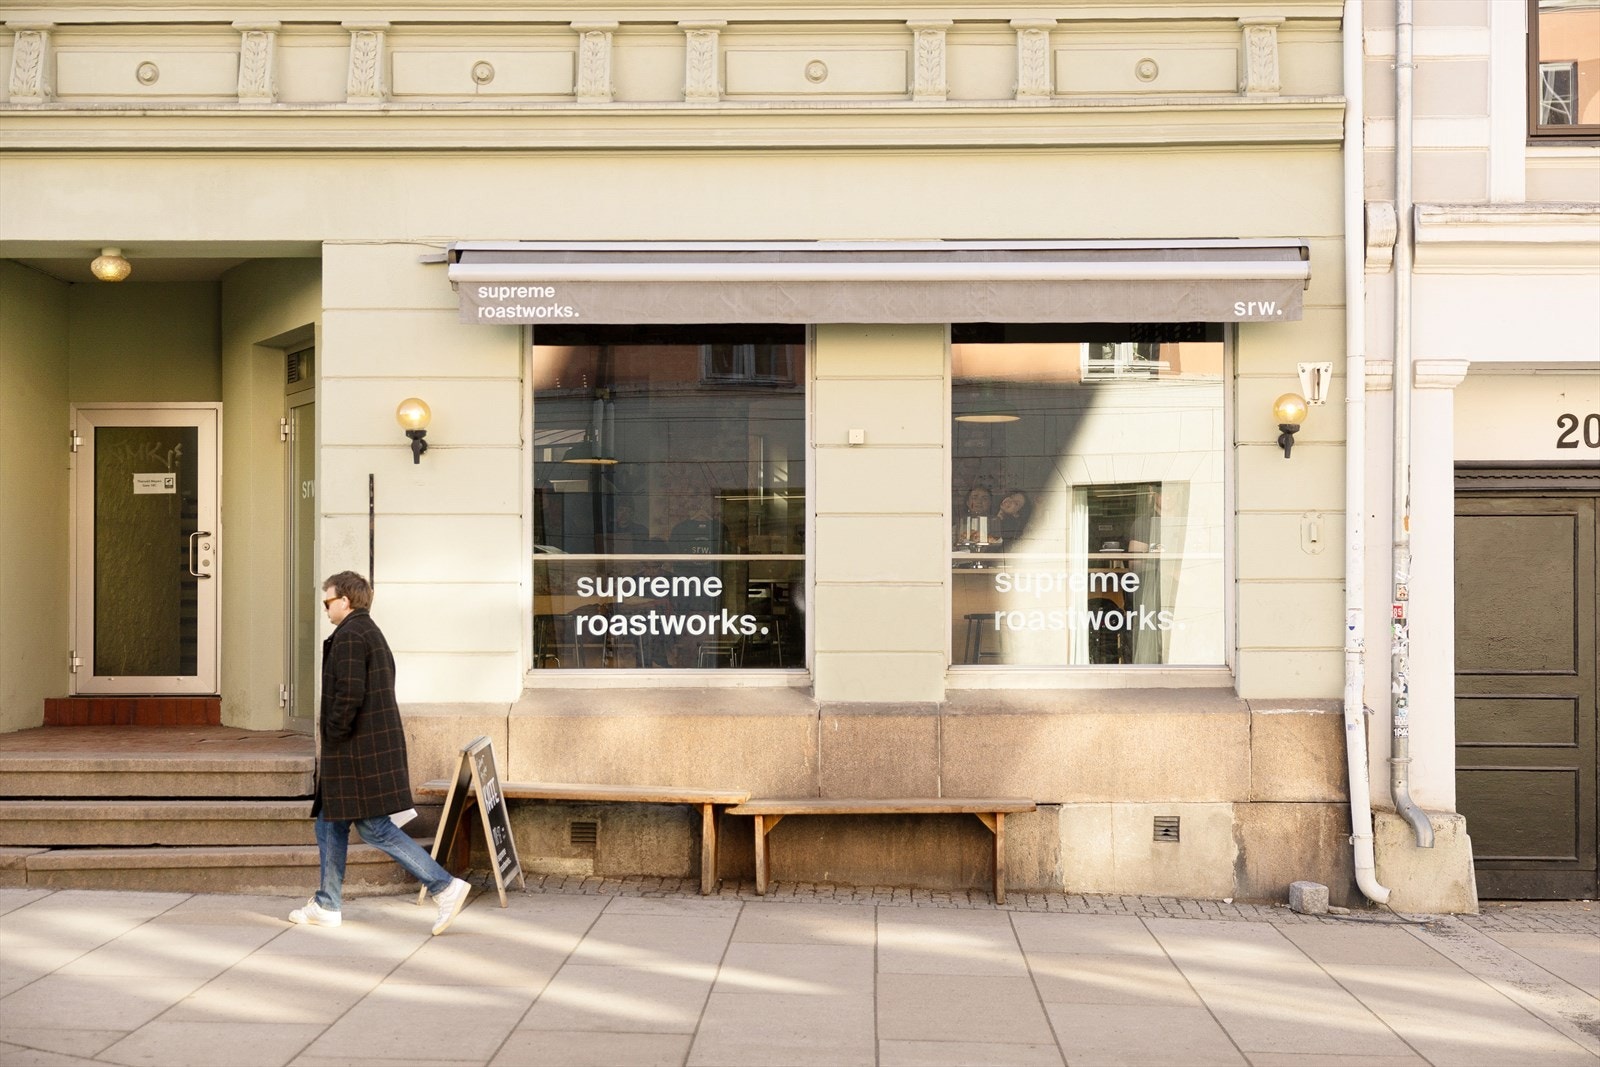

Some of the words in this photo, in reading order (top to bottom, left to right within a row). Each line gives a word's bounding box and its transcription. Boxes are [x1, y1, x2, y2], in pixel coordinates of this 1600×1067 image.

[478, 286, 555, 301] supreme
[478, 303, 580, 318] roastworks.
[1233, 301, 1283, 316] srw.
[1556, 413, 1600, 449] 20
[577, 575, 723, 603] supreme
[995, 571, 1140, 600] supreme
[576, 608, 769, 636] roastworks.
[994, 604, 1187, 631] roastworks.
